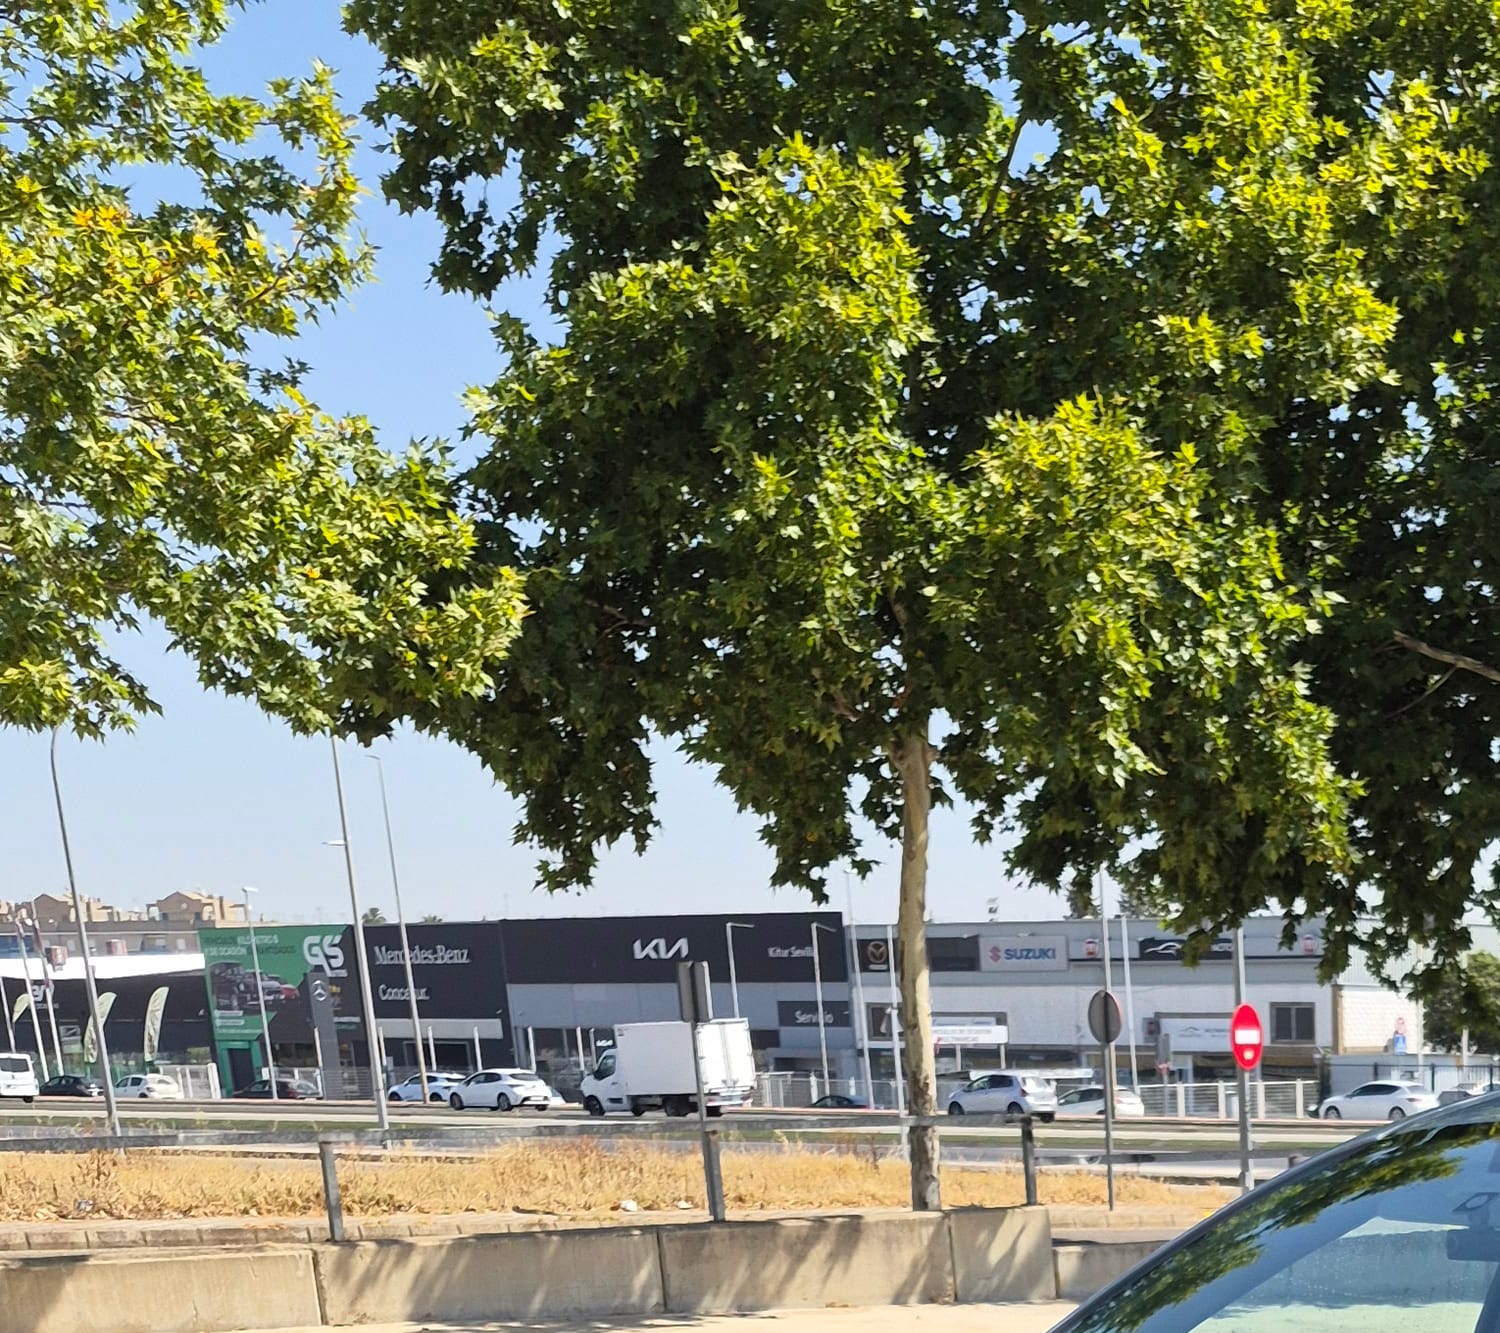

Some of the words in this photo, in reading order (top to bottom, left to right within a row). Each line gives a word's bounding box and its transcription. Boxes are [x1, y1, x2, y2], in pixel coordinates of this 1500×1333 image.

[633, 937, 689, 959] KIA
[1004, 948, 1056, 960] SUZUKI
[378, 984, 429, 1000] Conceur
[795, 1010, 834, 1023] Serviio
